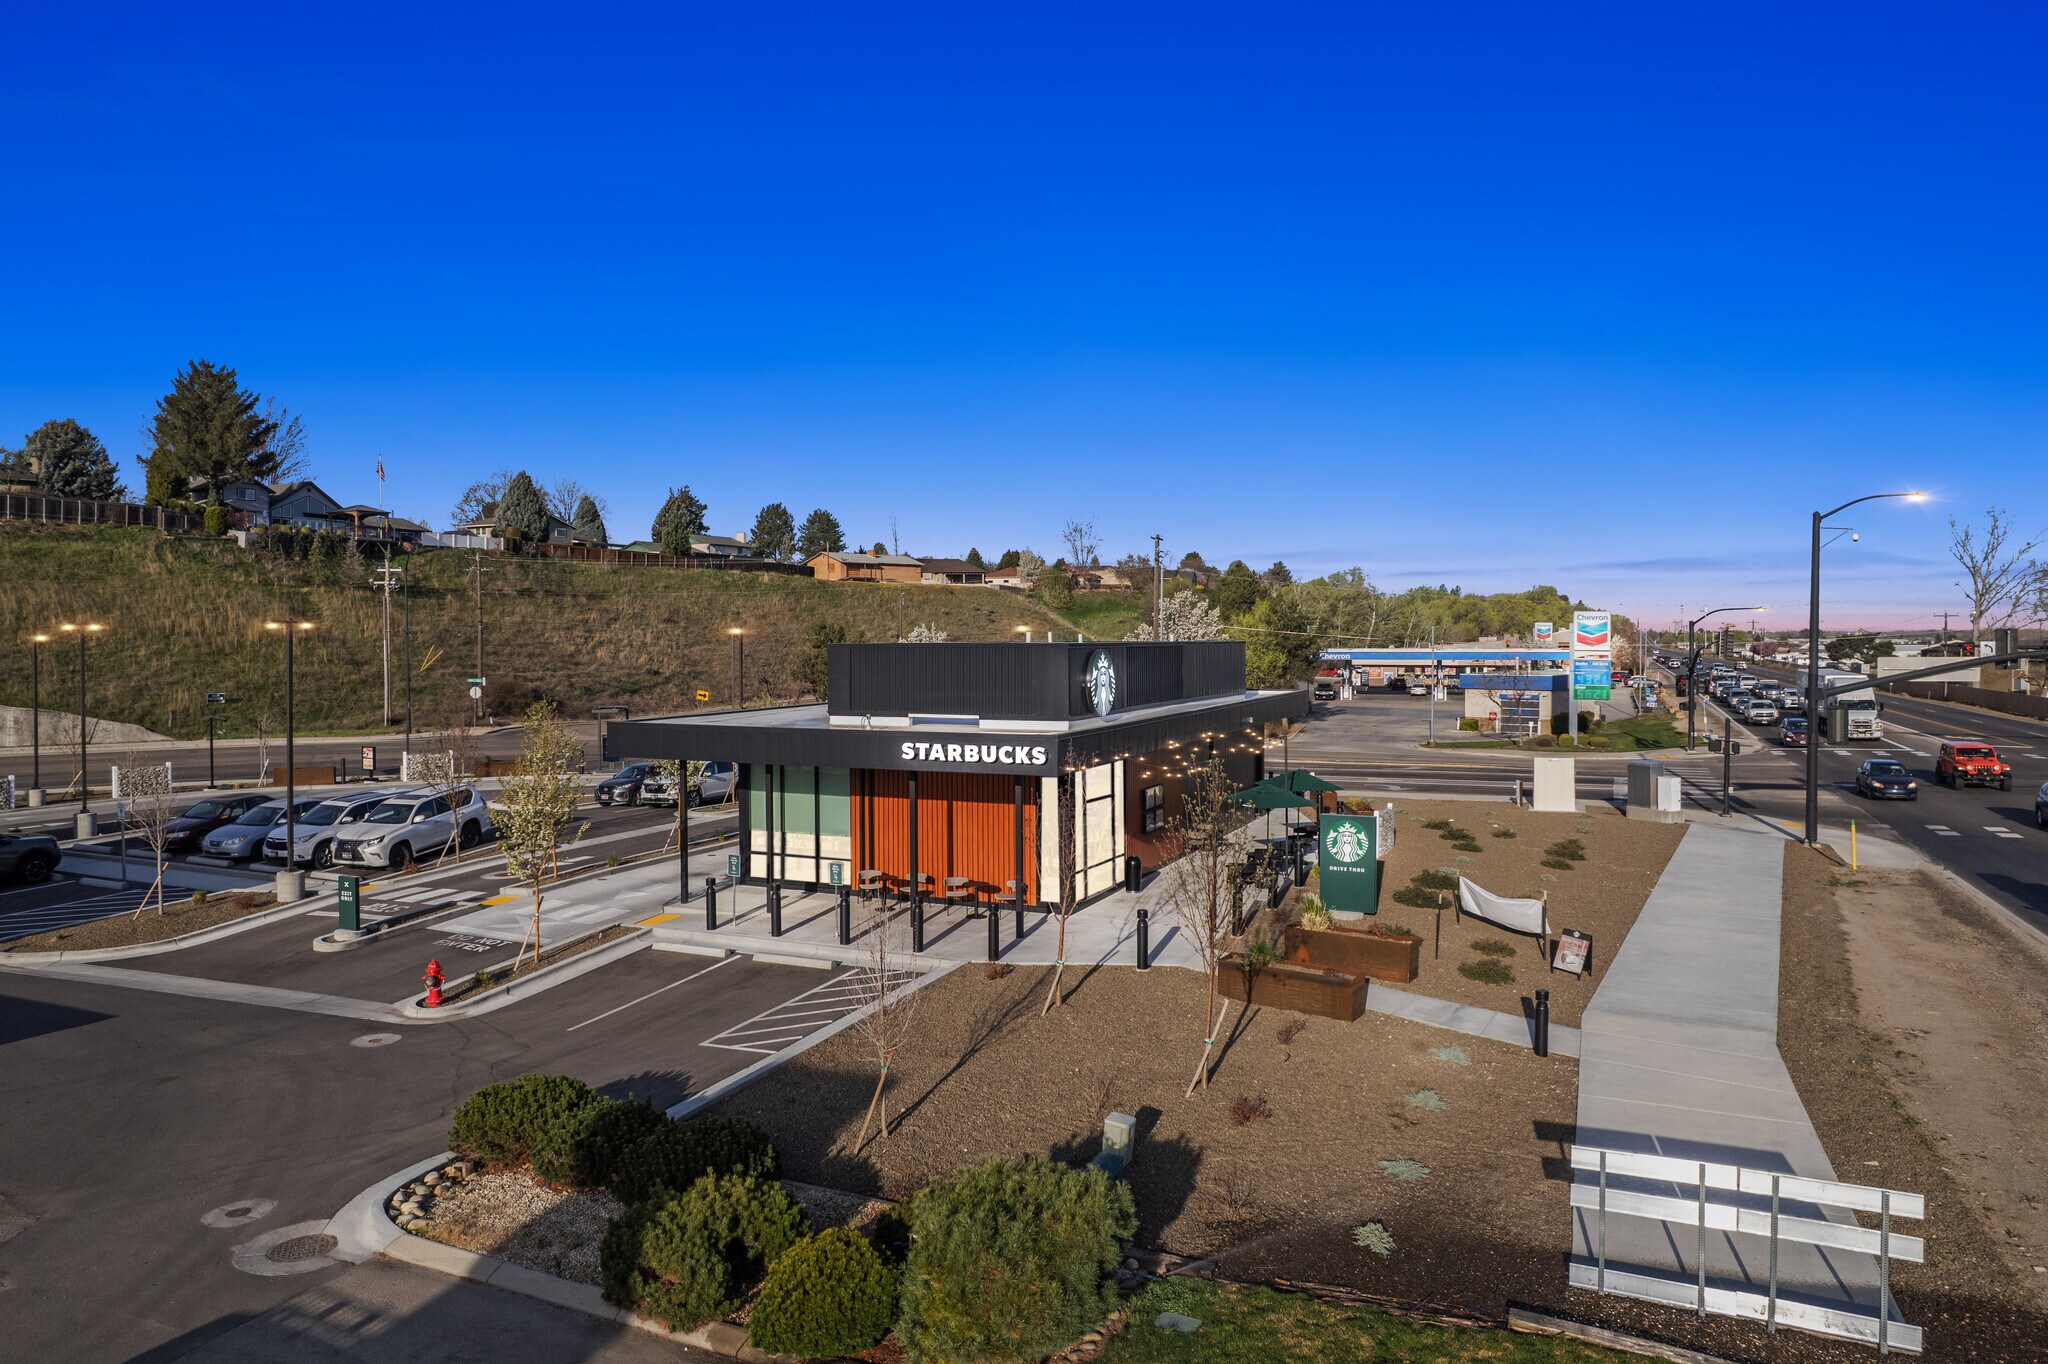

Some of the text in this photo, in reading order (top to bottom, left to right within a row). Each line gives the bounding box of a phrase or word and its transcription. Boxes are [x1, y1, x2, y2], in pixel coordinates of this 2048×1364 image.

[901, 742, 1047, 765] STARBUCKS
[432, 939, 491, 953] ENTER
[447, 933, 513, 947] DO NOT
